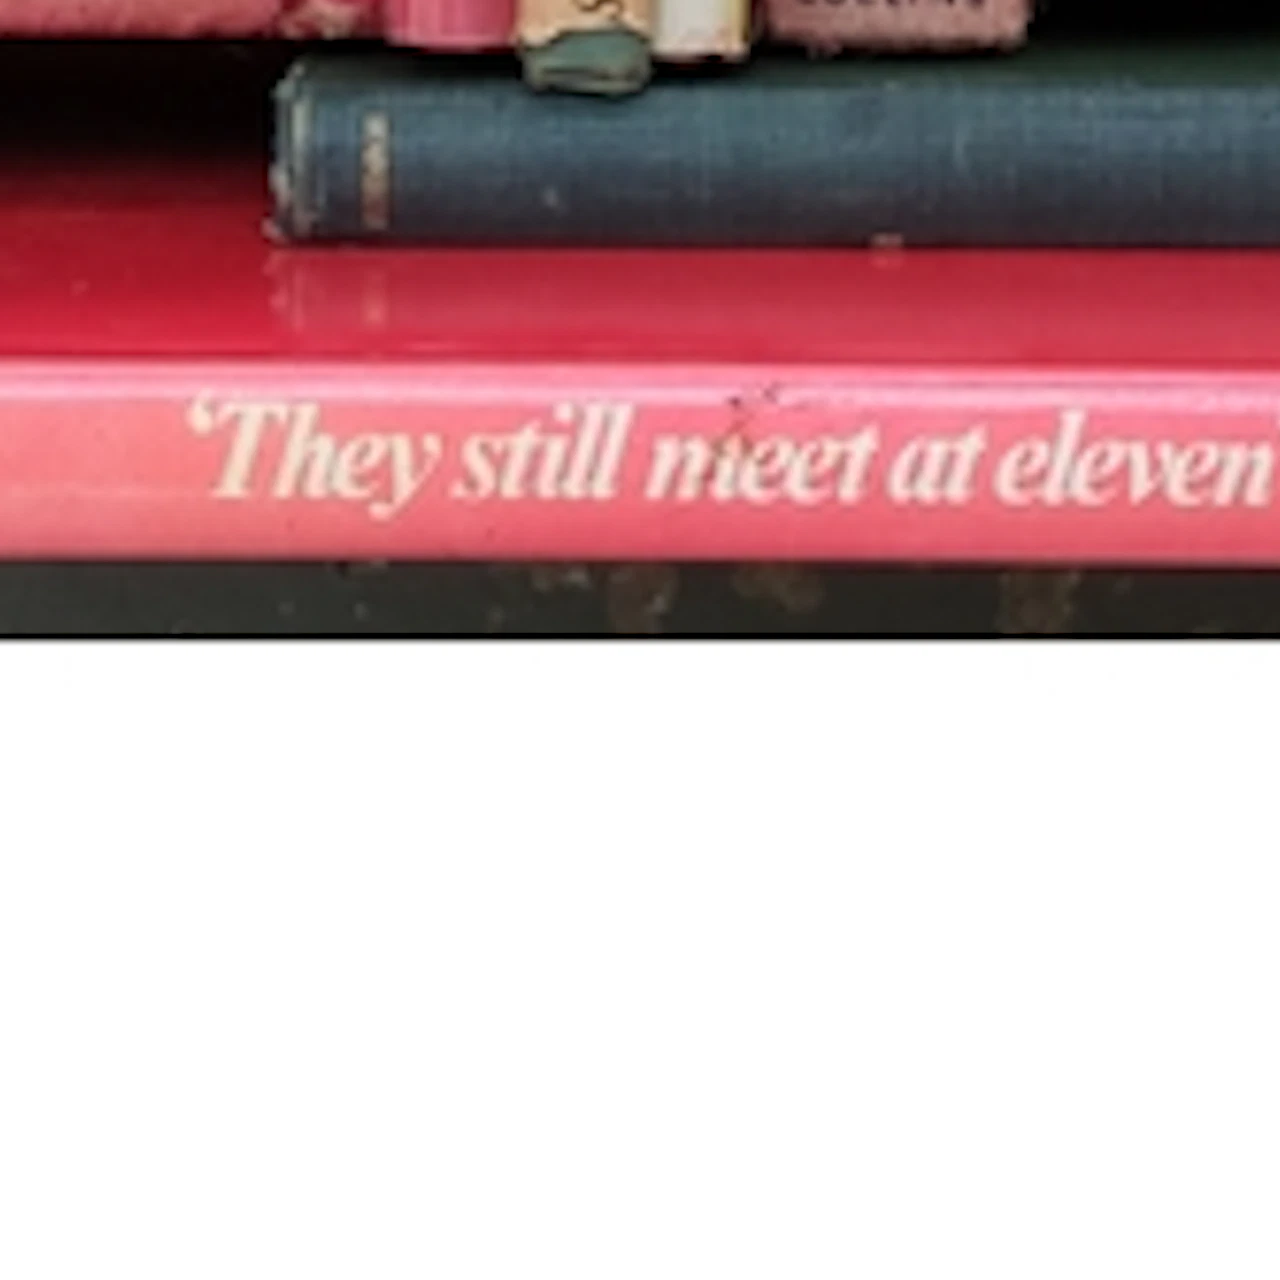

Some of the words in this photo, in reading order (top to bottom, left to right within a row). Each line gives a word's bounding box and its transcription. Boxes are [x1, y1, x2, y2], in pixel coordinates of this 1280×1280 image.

[450, 398, 635, 503] still
[643, 422, 880, 506] meet
[885, 426, 989, 507] at
